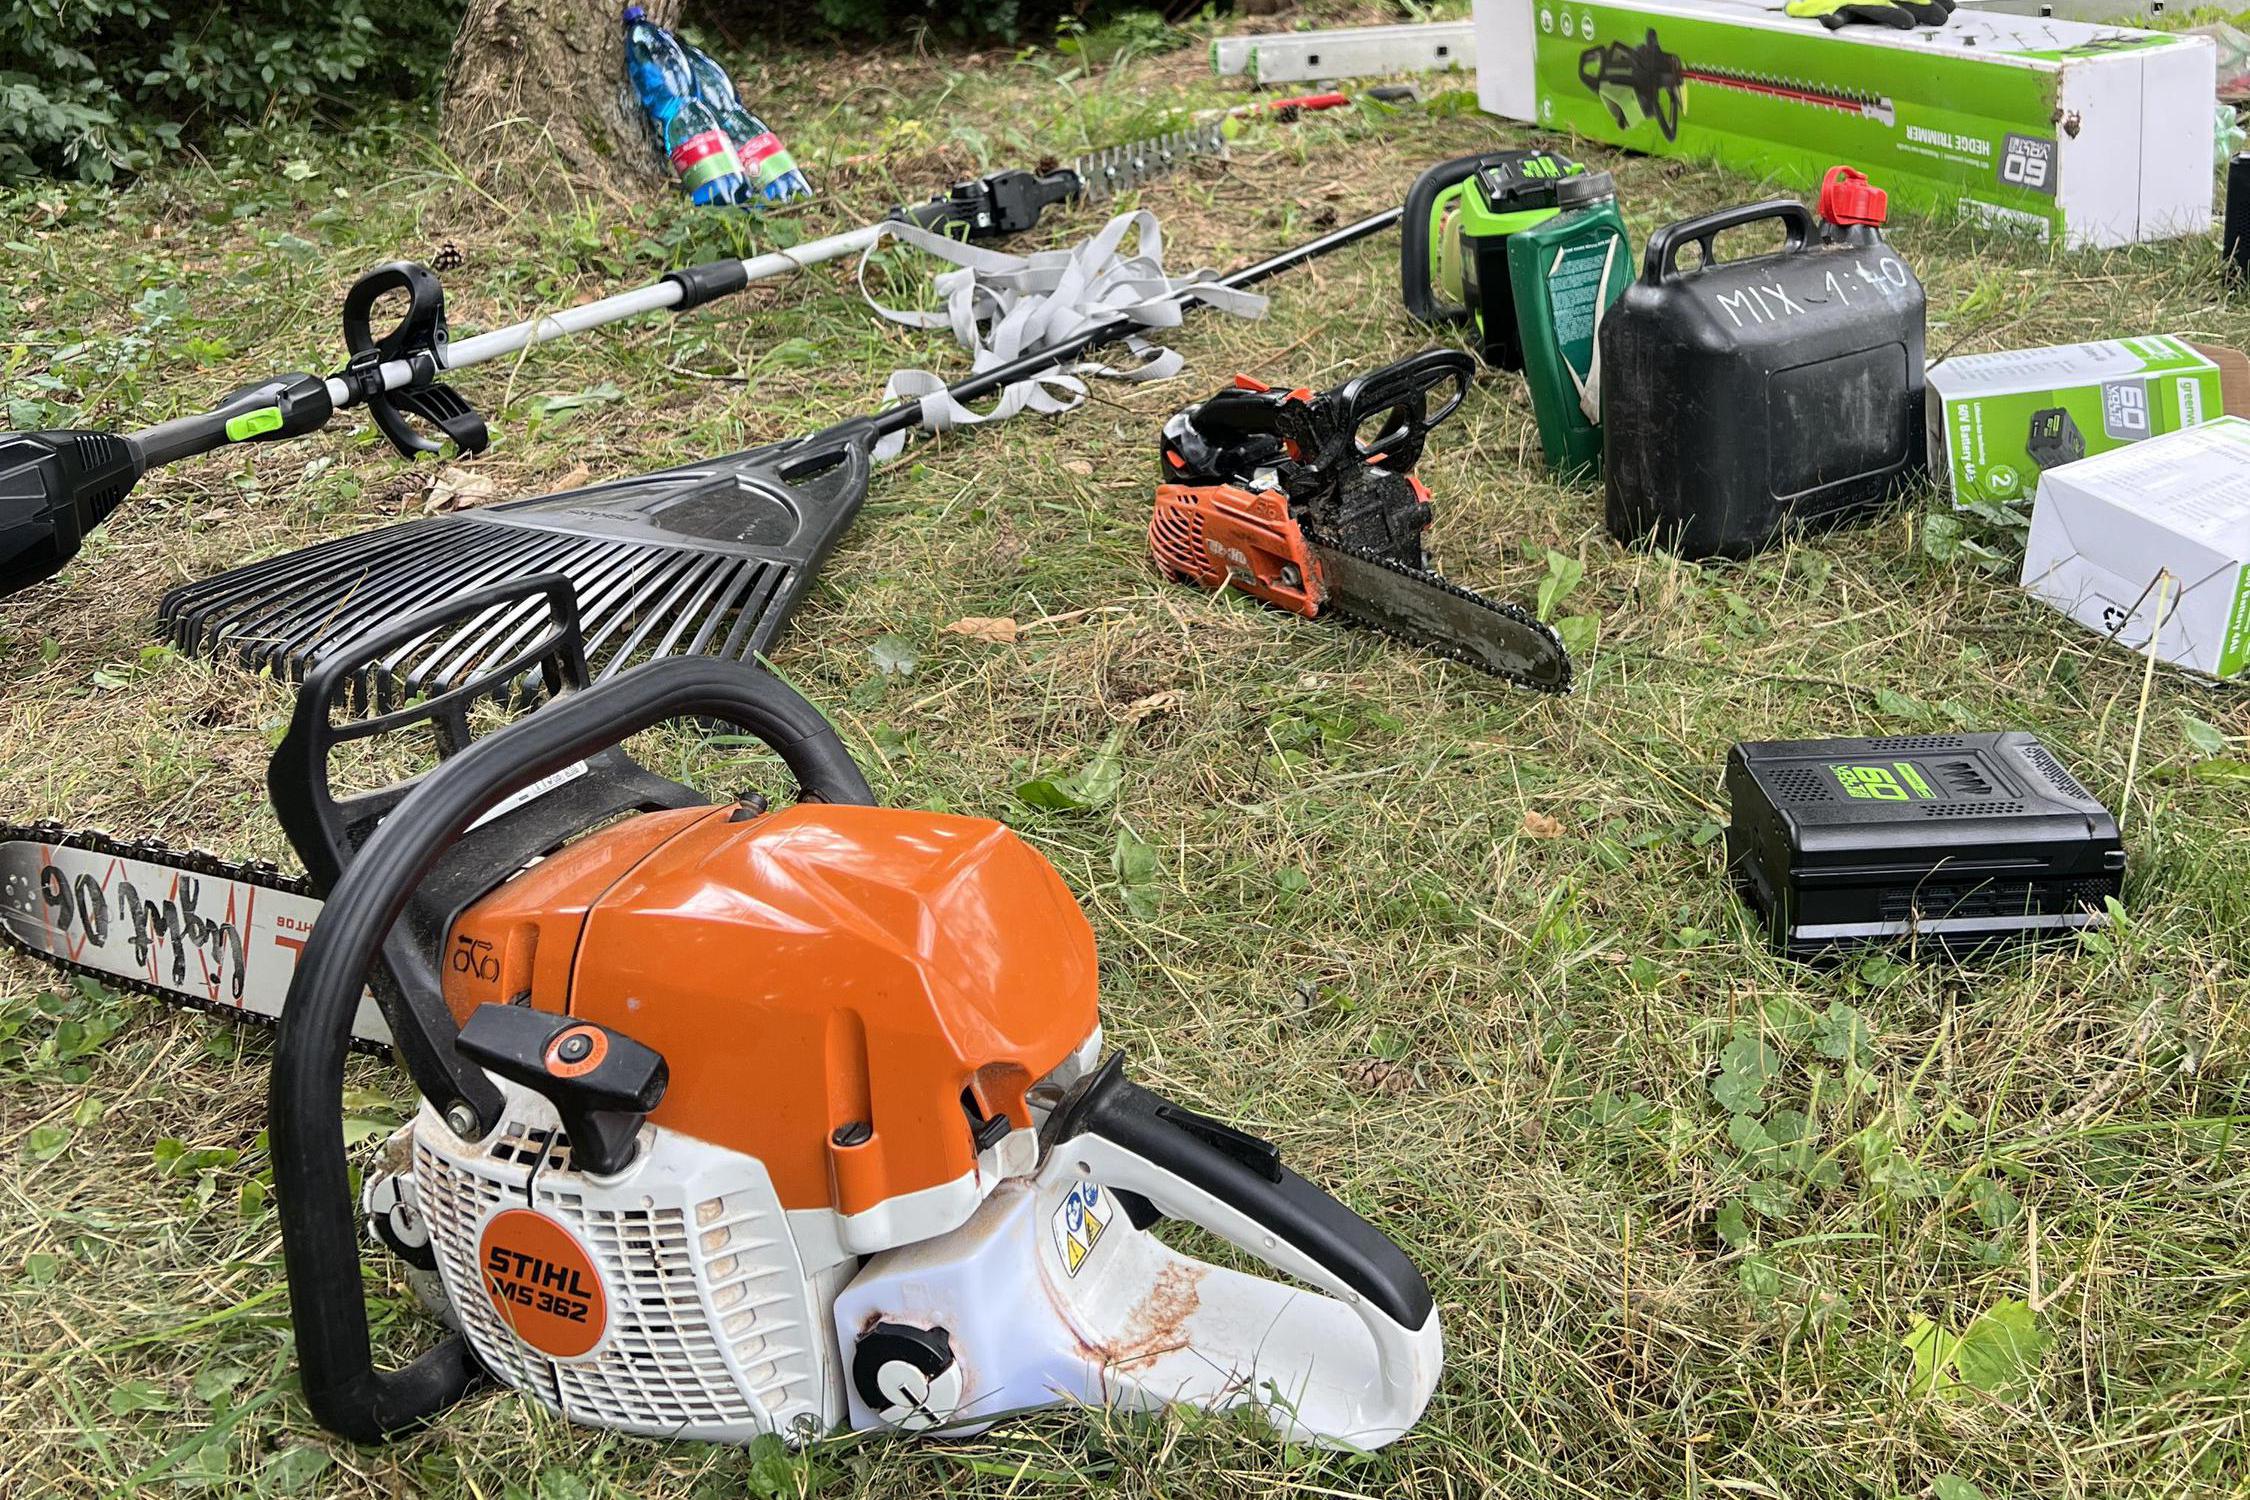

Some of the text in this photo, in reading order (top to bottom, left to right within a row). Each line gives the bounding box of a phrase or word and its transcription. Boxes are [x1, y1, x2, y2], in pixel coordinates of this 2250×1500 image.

[1906, 124, 1952, 149] TRIMMER
[1955, 135, 1990, 156] HEDGE
[2003, 154, 2047, 186] 60
[1716, 283, 1805, 327] MIX
[1958, 404, 1970, 422] 60V
[2120, 386, 2146, 429] 60
[1960, 425, 1972, 461] Battery
[1852, 767, 1909, 799] 60
[40, 864, 109, 948] 06
[488, 1246, 592, 1300] STIHL
[492, 1277, 589, 1324] MS 362
